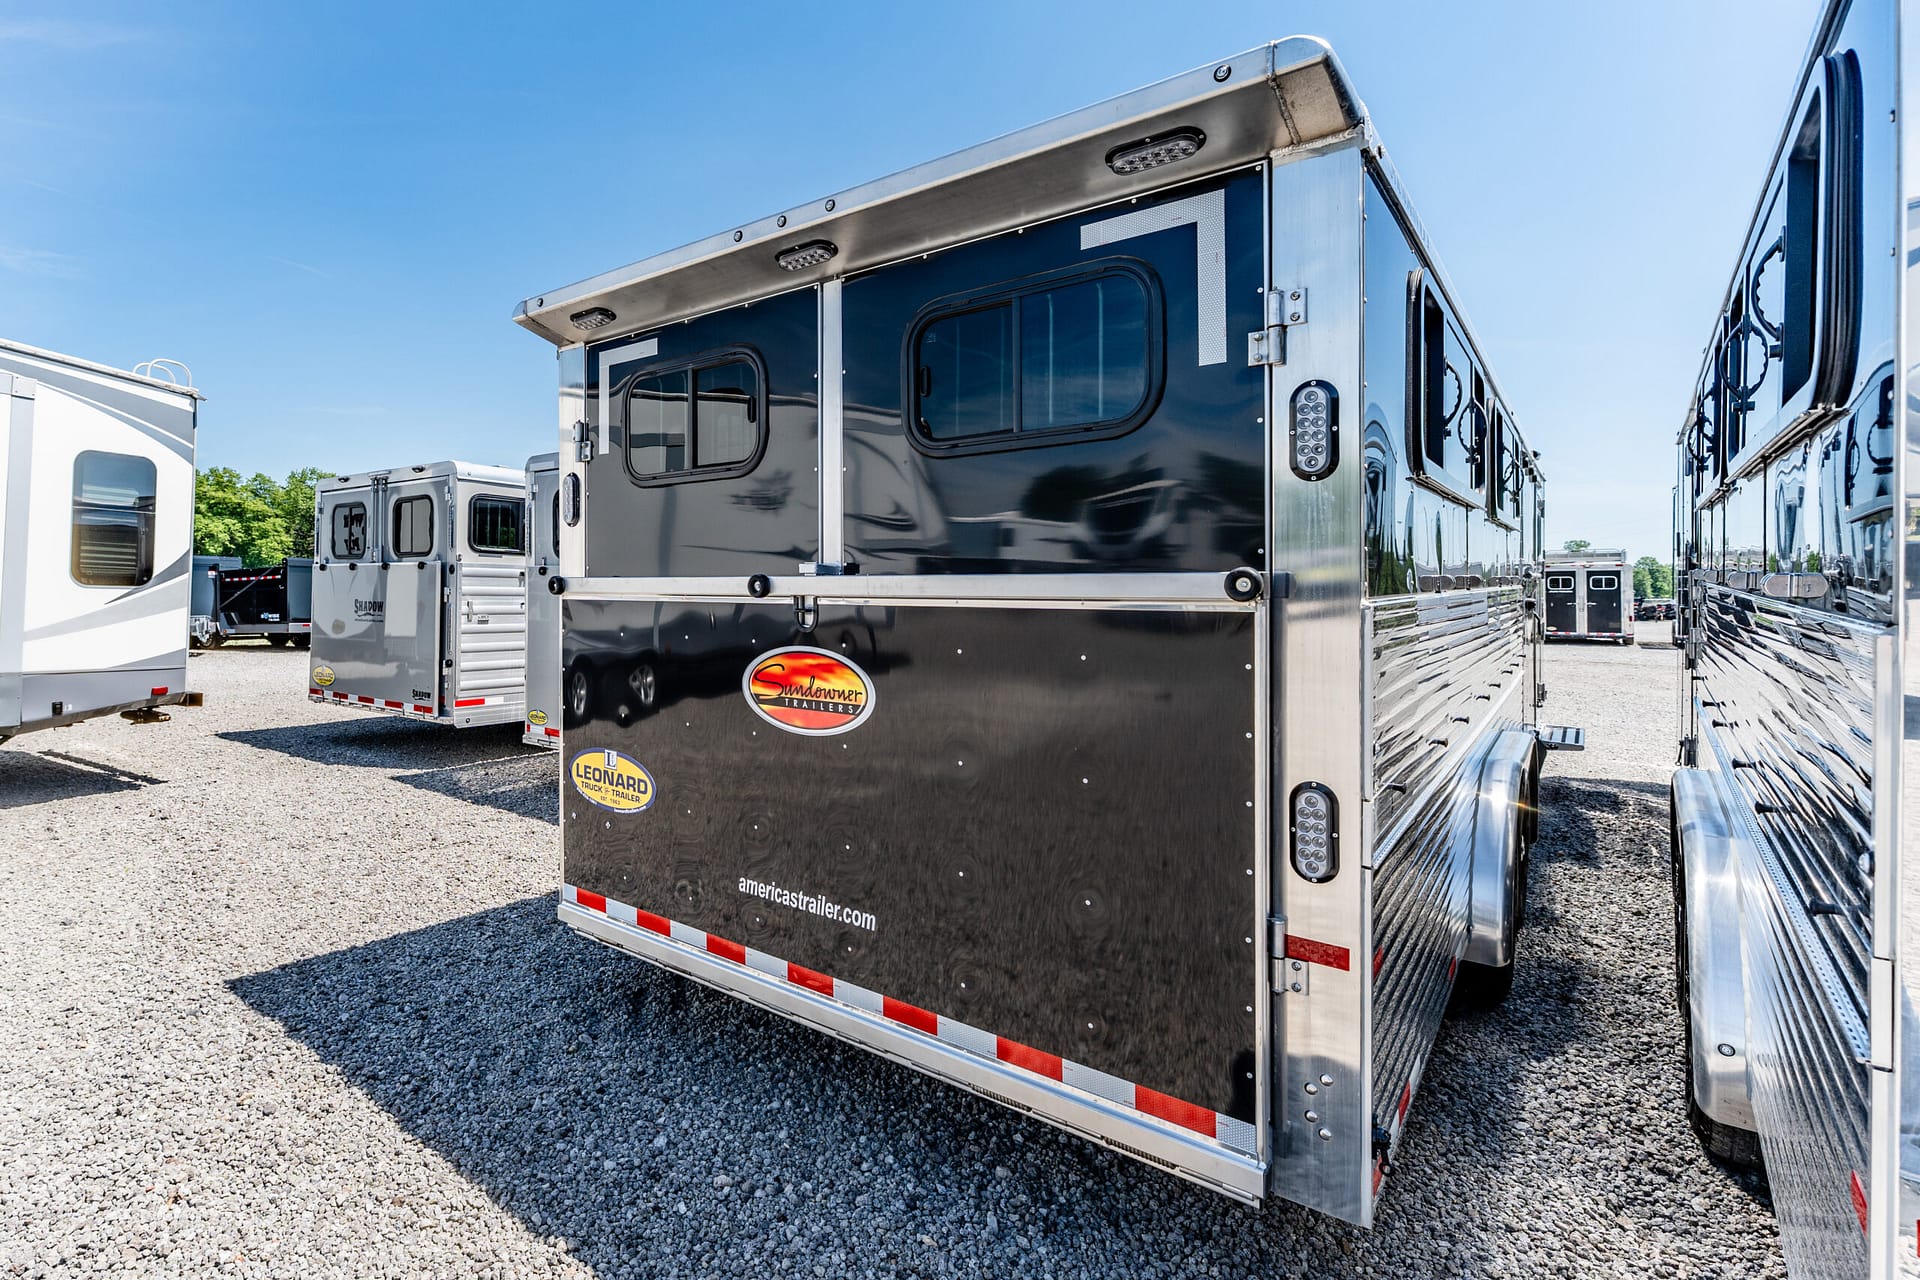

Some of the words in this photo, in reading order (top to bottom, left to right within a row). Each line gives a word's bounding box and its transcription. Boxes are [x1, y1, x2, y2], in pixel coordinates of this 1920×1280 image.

[354, 599, 384, 614] SHADOW
[754, 663, 863, 702] Sundowner
[784, 698, 854, 713] TRAILERS
[576, 763, 648, 795] LEONARD
[581, 781, 603, 793] TRUCK
[611, 788, 641, 803] TRAILER
[738, 877, 876, 931] americastrailer.com
